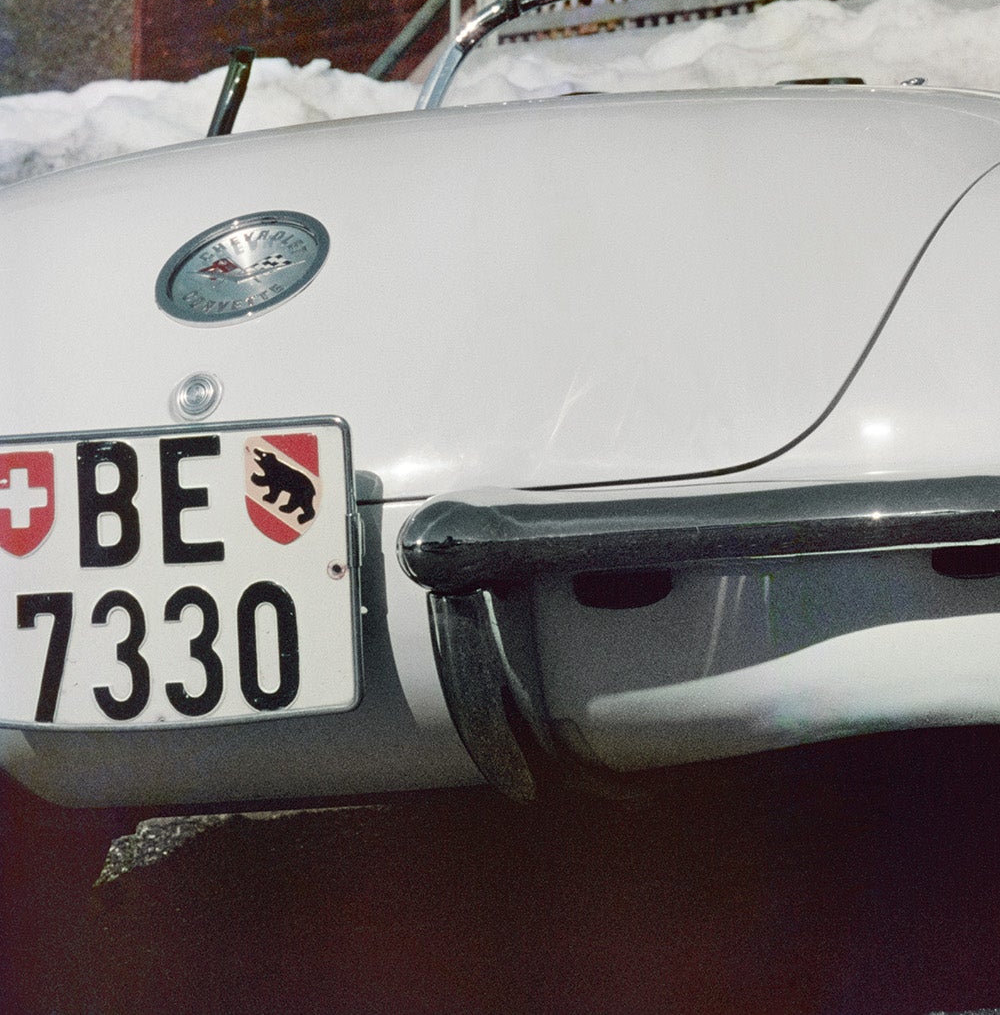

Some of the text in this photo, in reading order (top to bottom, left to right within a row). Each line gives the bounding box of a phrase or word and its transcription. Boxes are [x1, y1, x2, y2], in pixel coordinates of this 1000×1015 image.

[200, 229, 309, 262] CHEVROLET
[182, 283, 285, 314] CORVETTE
[76, 435, 225, 568] BE
[16, 580, 300, 723] 7330
